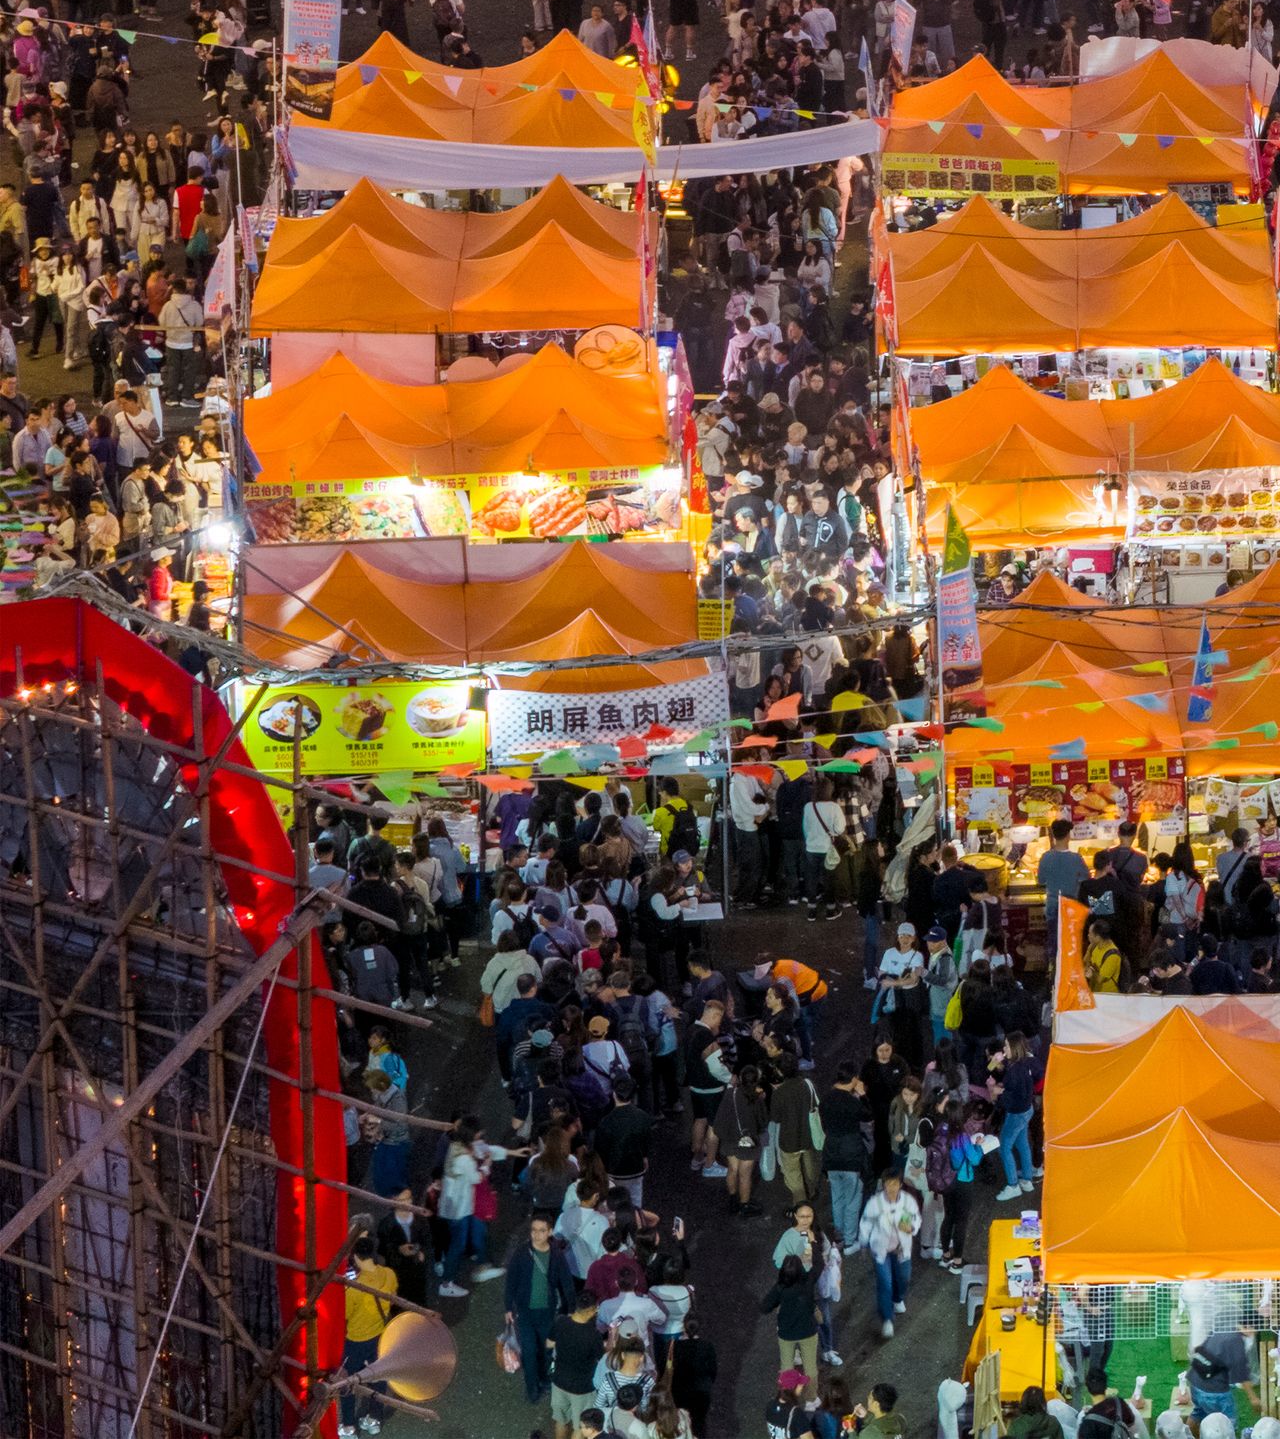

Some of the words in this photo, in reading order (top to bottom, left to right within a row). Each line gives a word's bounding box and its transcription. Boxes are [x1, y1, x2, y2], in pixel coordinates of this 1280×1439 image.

[525, 696, 697, 735] 朗屏魚肉翅
